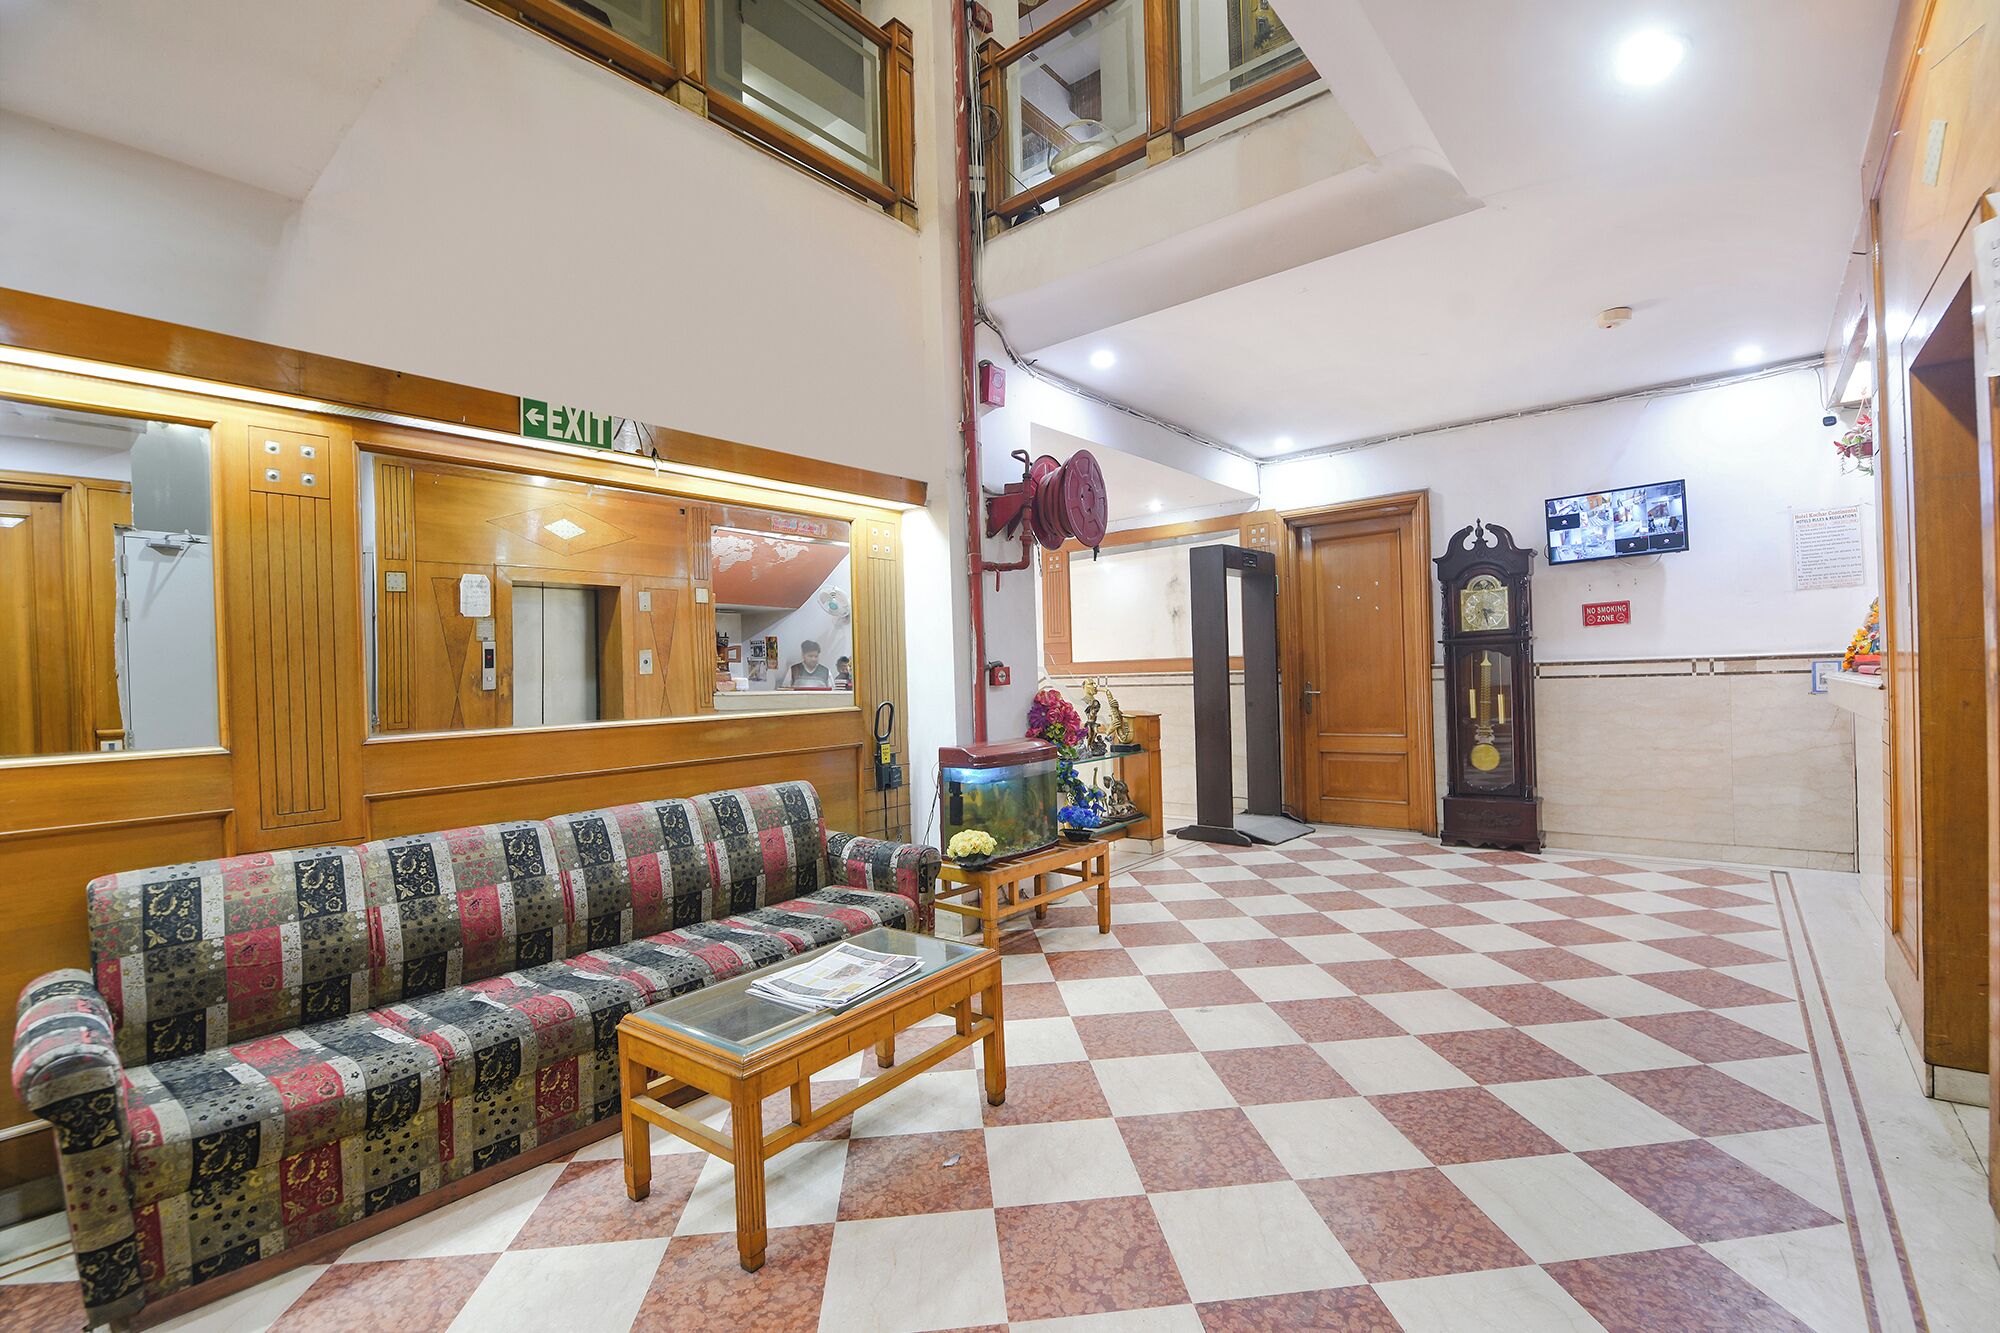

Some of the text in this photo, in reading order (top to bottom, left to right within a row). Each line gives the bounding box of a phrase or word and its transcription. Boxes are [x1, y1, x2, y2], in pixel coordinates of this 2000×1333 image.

[546, 402, 609, 445] EXIT
[1597, 605, 1627, 613] SMOKING
[1597, 614, 1614, 622] ZONE
